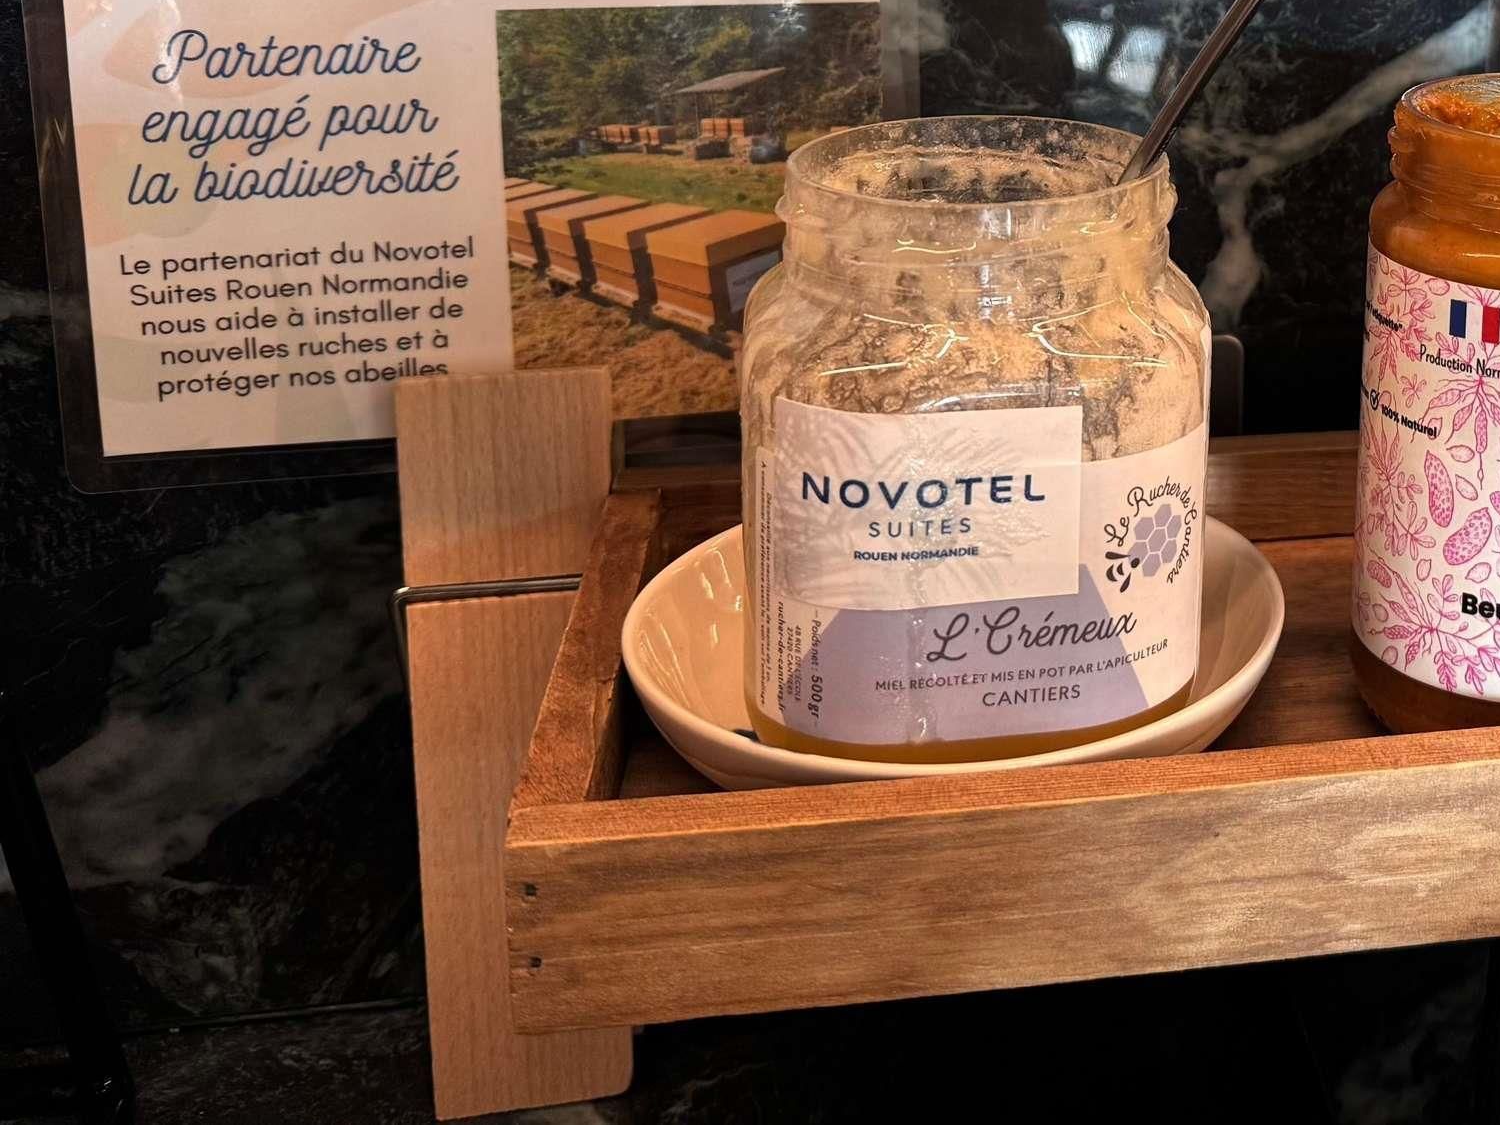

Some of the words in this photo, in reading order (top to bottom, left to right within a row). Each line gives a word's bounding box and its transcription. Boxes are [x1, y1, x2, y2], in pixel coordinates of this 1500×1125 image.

[151, 28, 422, 86] Partenaire
[141, 92, 310, 159] engagé
[319, 97, 439, 149] pour
[128, 159, 178, 206] la
[194, 148, 460, 204] biodiversité
[119, 253, 154, 276] Le
[162, 246, 321, 279] partenariat
[330, 241, 364, 267] du
[373, 236, 474, 262] Novotel
[130, 282, 217, 306] Suites
[226, 278, 315, 302] Rouen
[322, 270, 468, 296] Normandie
[141, 314, 206, 335] nous
[215, 307, 278, 331] aide
[287, 305, 305, 328] à
[314, 301, 423, 326] installer
[431, 298, 463, 320] de
[160, 337, 291, 364] nouvelles
[298, 334, 388, 359] ruches
[396, 334, 425, 354] et
[432, 330, 448, 350] à
[1419, 345, 1472, 373] Production
[157, 370, 280, 401] protéger
[288, 366, 335, 388] nos
[1380, 404, 1399, 424] 100%
[1401, 416, 1437, 436] Naturel
[802, 473, 1045, 509] NOVOTEL
[869, 518, 971, 538] SUITES
[1104, 516, 1129, 547] Le
[1127, 475, 1180, 517] Rucher
[1167, 501, 1197, 586] Cantiers
[854, 550, 897, 561] ROUEN
[901, 547, 979, 561] NORMANDIE
[810, 619, 822, 647] Poids
[811, 648, 820, 666] net
[875, 680, 903, 690] MIEL
[907, 674, 968, 690] RÉCOLTÉ
[970, 673, 987, 684] ET
[991, 671, 1014, 682] MIS
[1018, 669, 1035, 680] EN
[1039, 667, 1065, 679] POT
[1068, 664, 1093, 677] PAR
[1096, 639, 1168, 674] L'APICULTEUR
[811, 674, 823, 701] 500
[982, 685, 1080, 708] CANTIERS
[808, 703, 821, 720] gr
